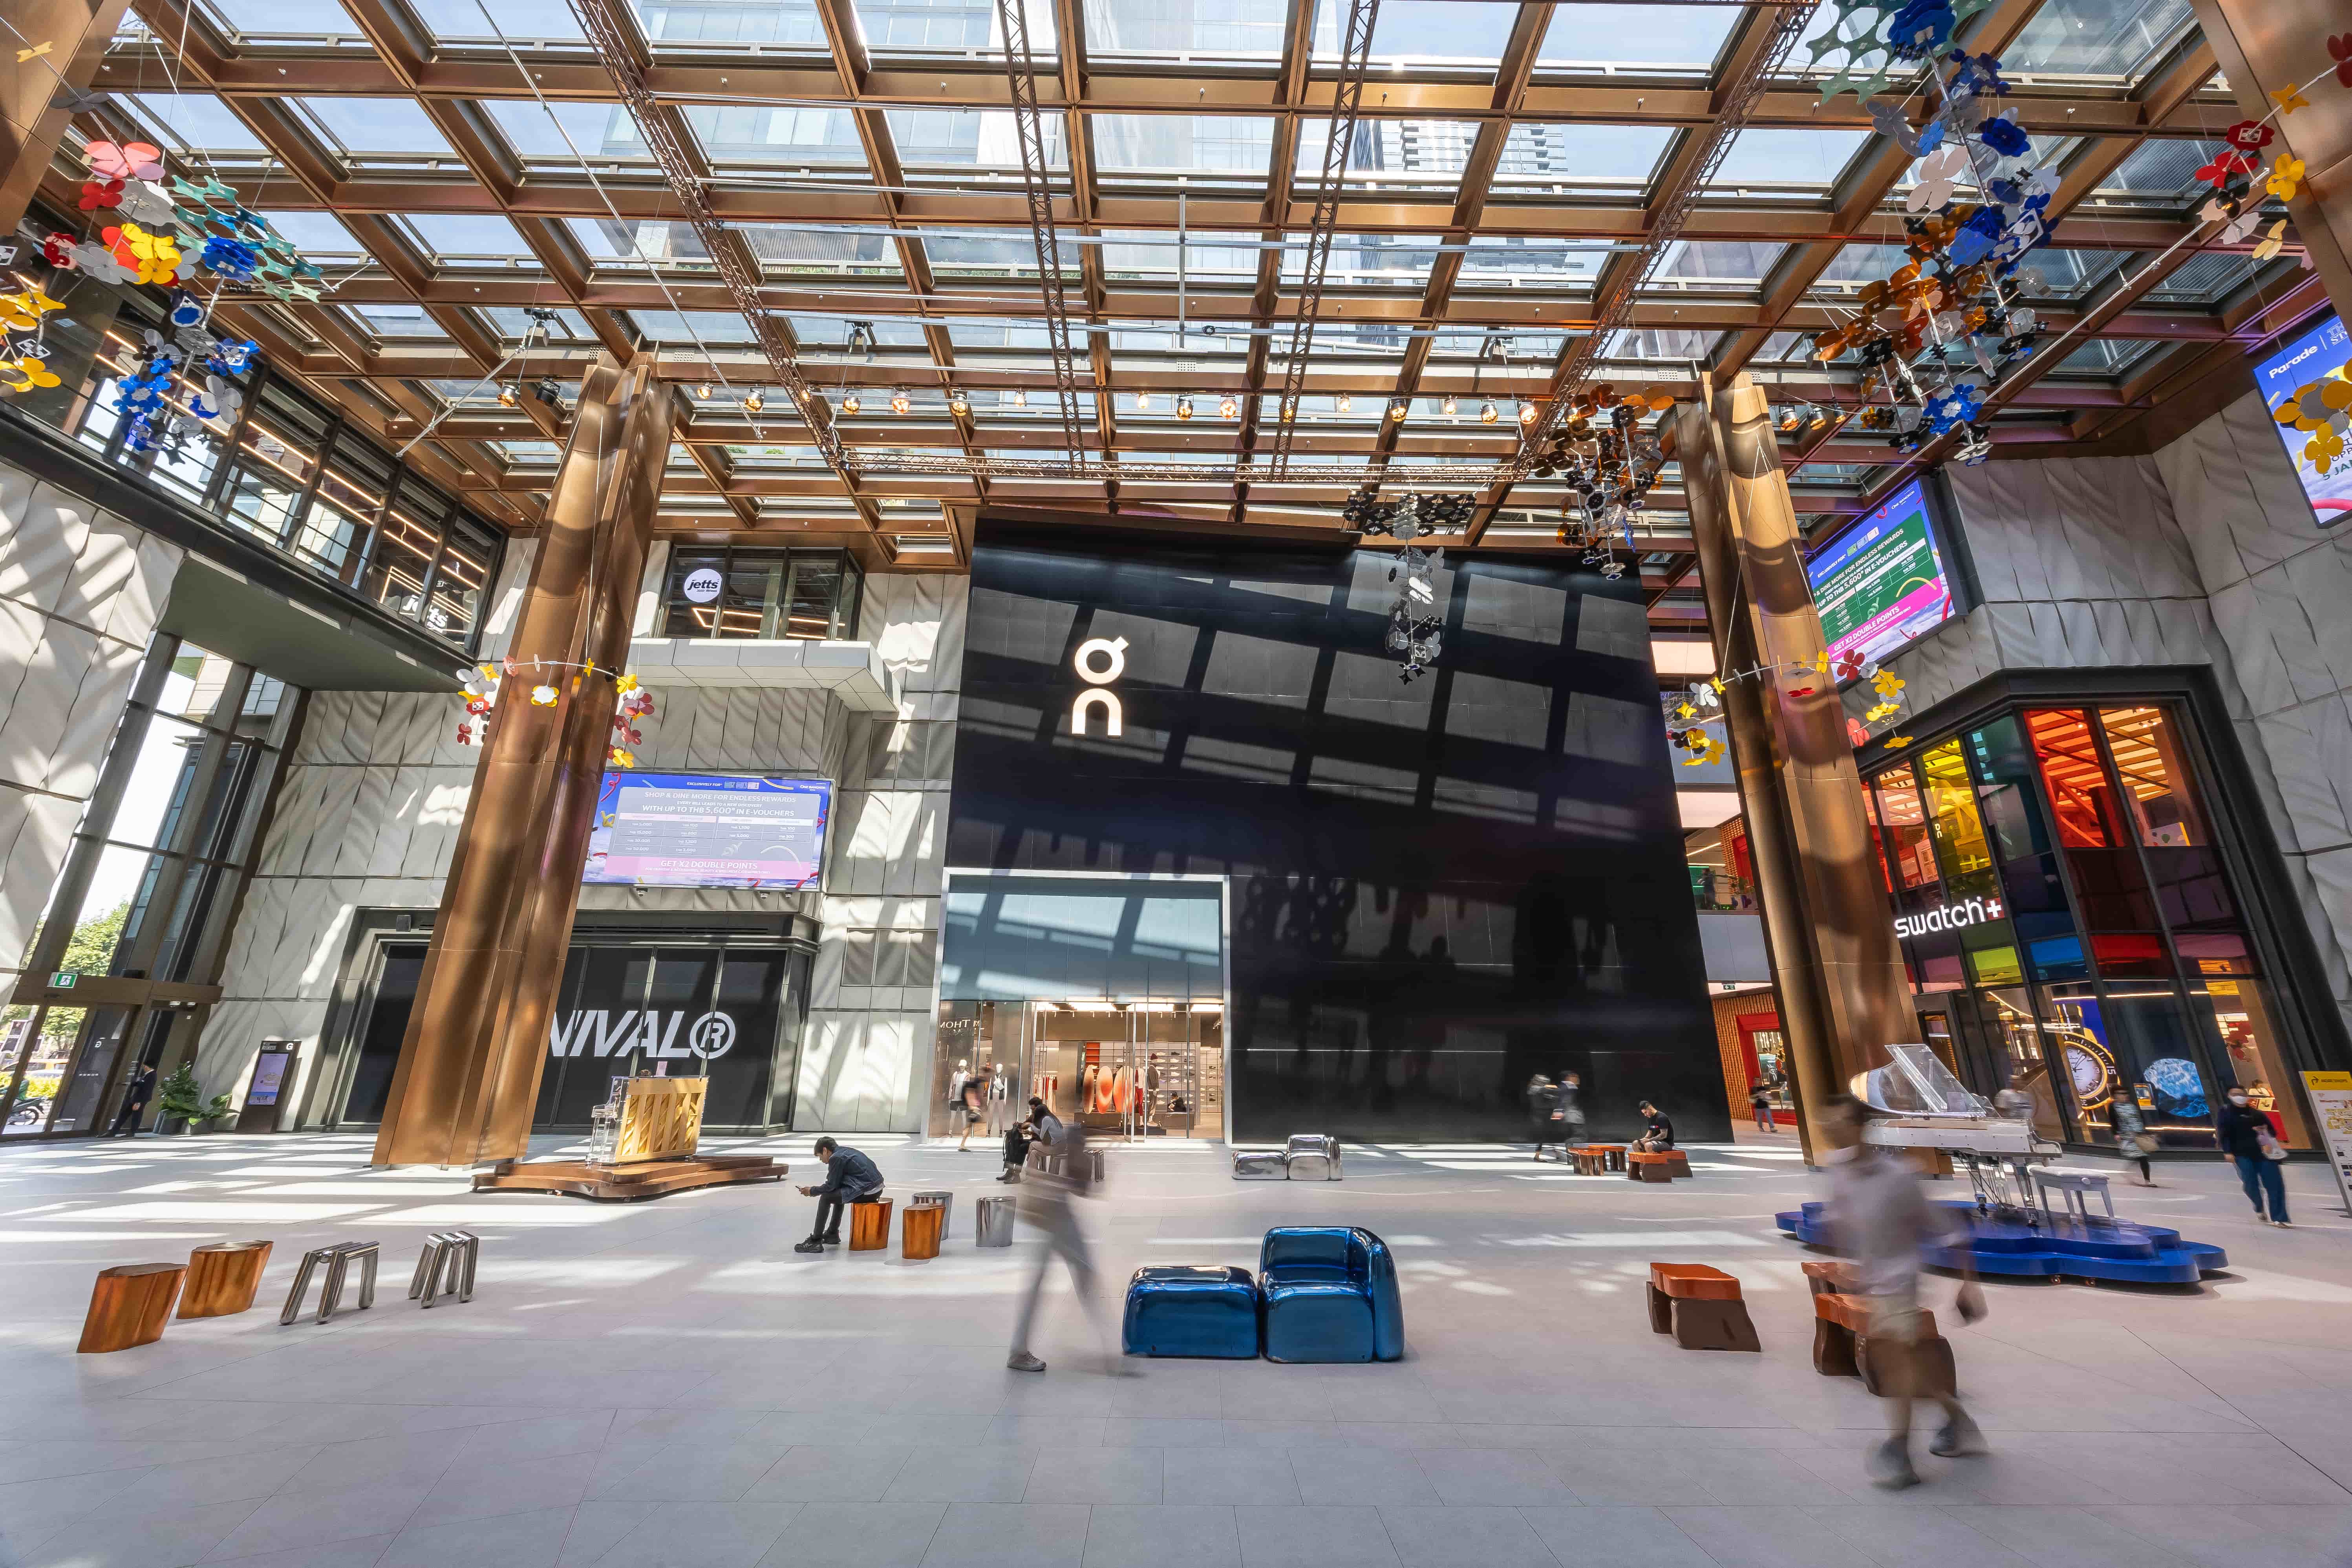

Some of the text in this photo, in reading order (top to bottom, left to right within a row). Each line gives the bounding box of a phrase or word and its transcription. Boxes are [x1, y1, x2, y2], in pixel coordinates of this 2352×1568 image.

[2269, 346, 2318, 379] Parade
[1817, 559, 1838, 578] EXCLUSIVELY
[1819, 598, 1826, 607] UP
[1826, 593, 1834, 602] TO
[1833, 585, 1844, 597] THB
[1864, 565, 1871, 575] IN
[1871, 540, 1908, 570] E-VOUCHERS
[1820, 581, 1831, 593] DINE
[1831, 571, 1845, 585] MORE
[1845, 564, 1855, 575] FOR
[1855, 547, 1877, 567] ENDLESS
[1877, 528, 1904, 551] REWARDS
[687, 579, 718, 590] jetts
[1825, 587, 1834, 596] EVERY
[1840, 575, 1849, 585] LEADS
[1834, 640, 1845, 651] GET
[1845, 635, 1853, 645] X2
[1852, 620, 1876, 640] DOUBLE
[1876, 605, 1900, 625] POINTS
